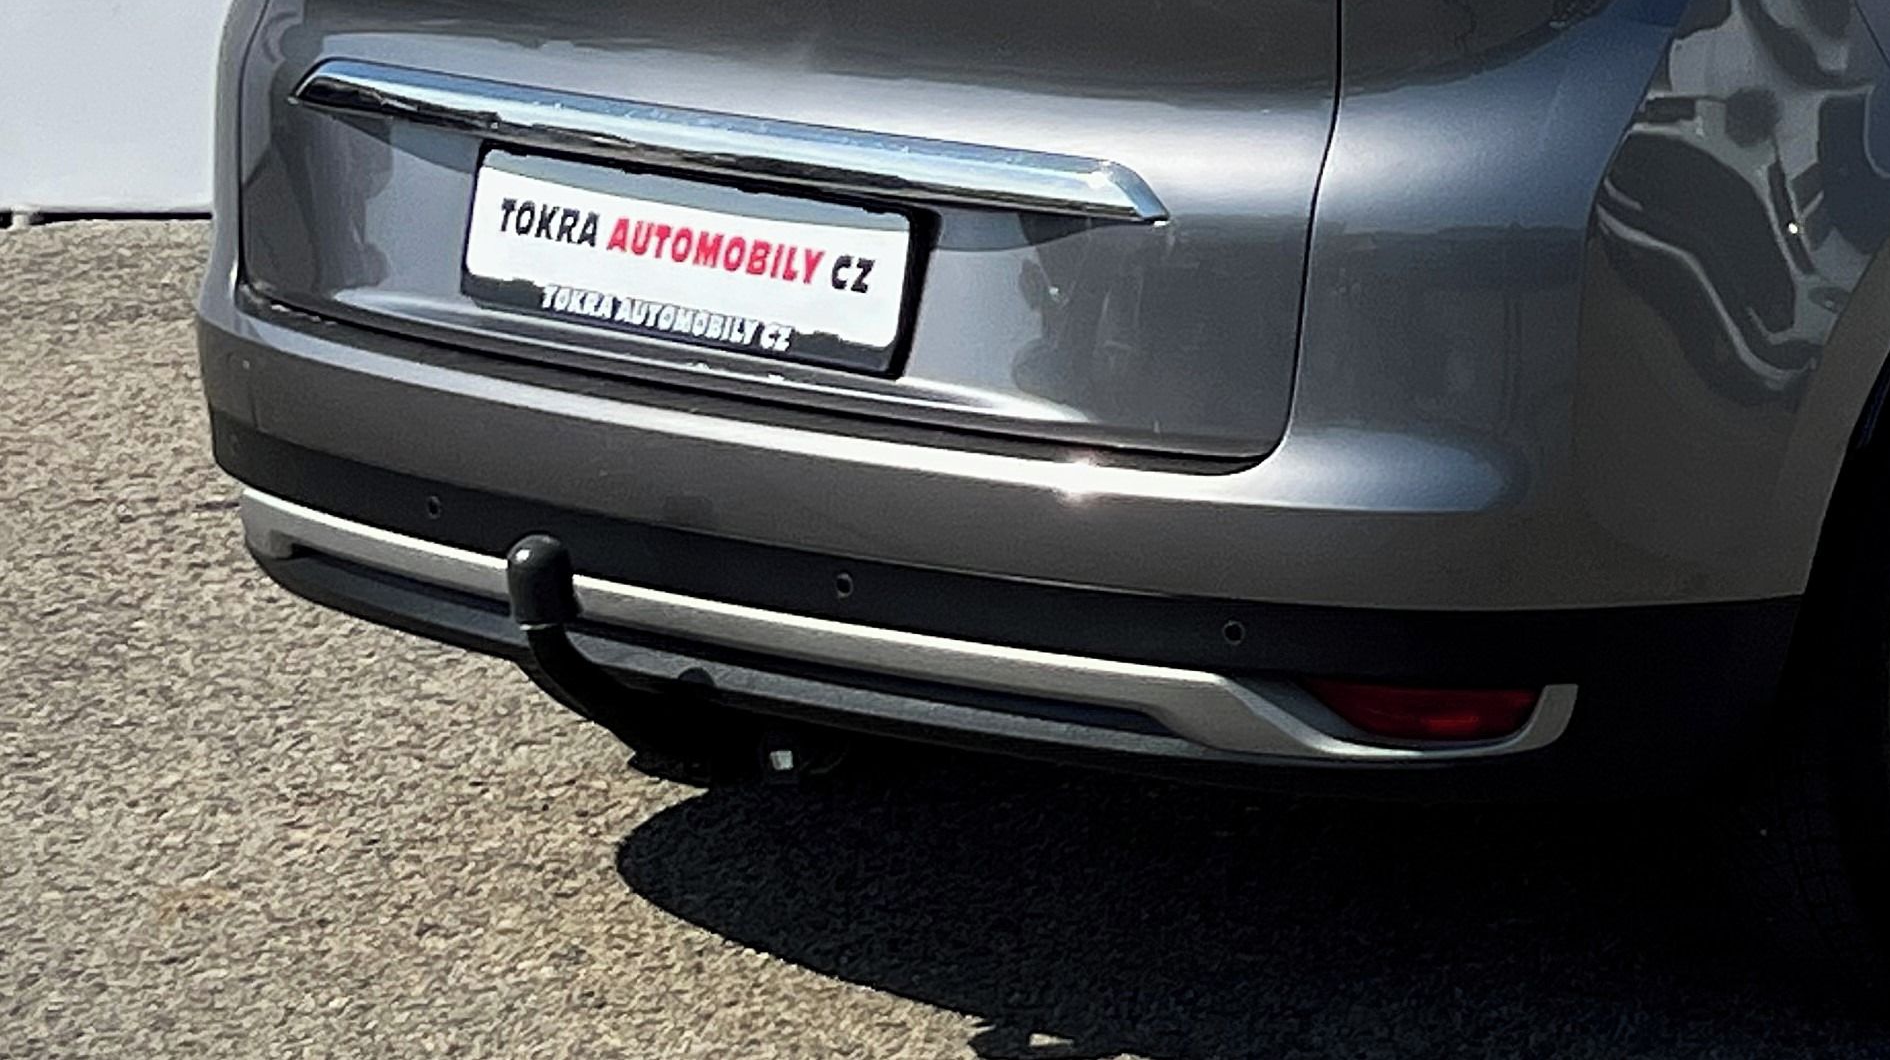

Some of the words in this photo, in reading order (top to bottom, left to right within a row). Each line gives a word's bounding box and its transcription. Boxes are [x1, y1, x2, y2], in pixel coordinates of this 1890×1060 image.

[501, 198, 600, 248] TOKRA
[606, 218, 825, 284] AUTOMOBILY
[832, 254, 876, 294] CZ
[542, 285, 615, 322] TOKRA
[615, 297, 760, 345] AUTOMOBILY
[759, 323, 795, 351] CZ
